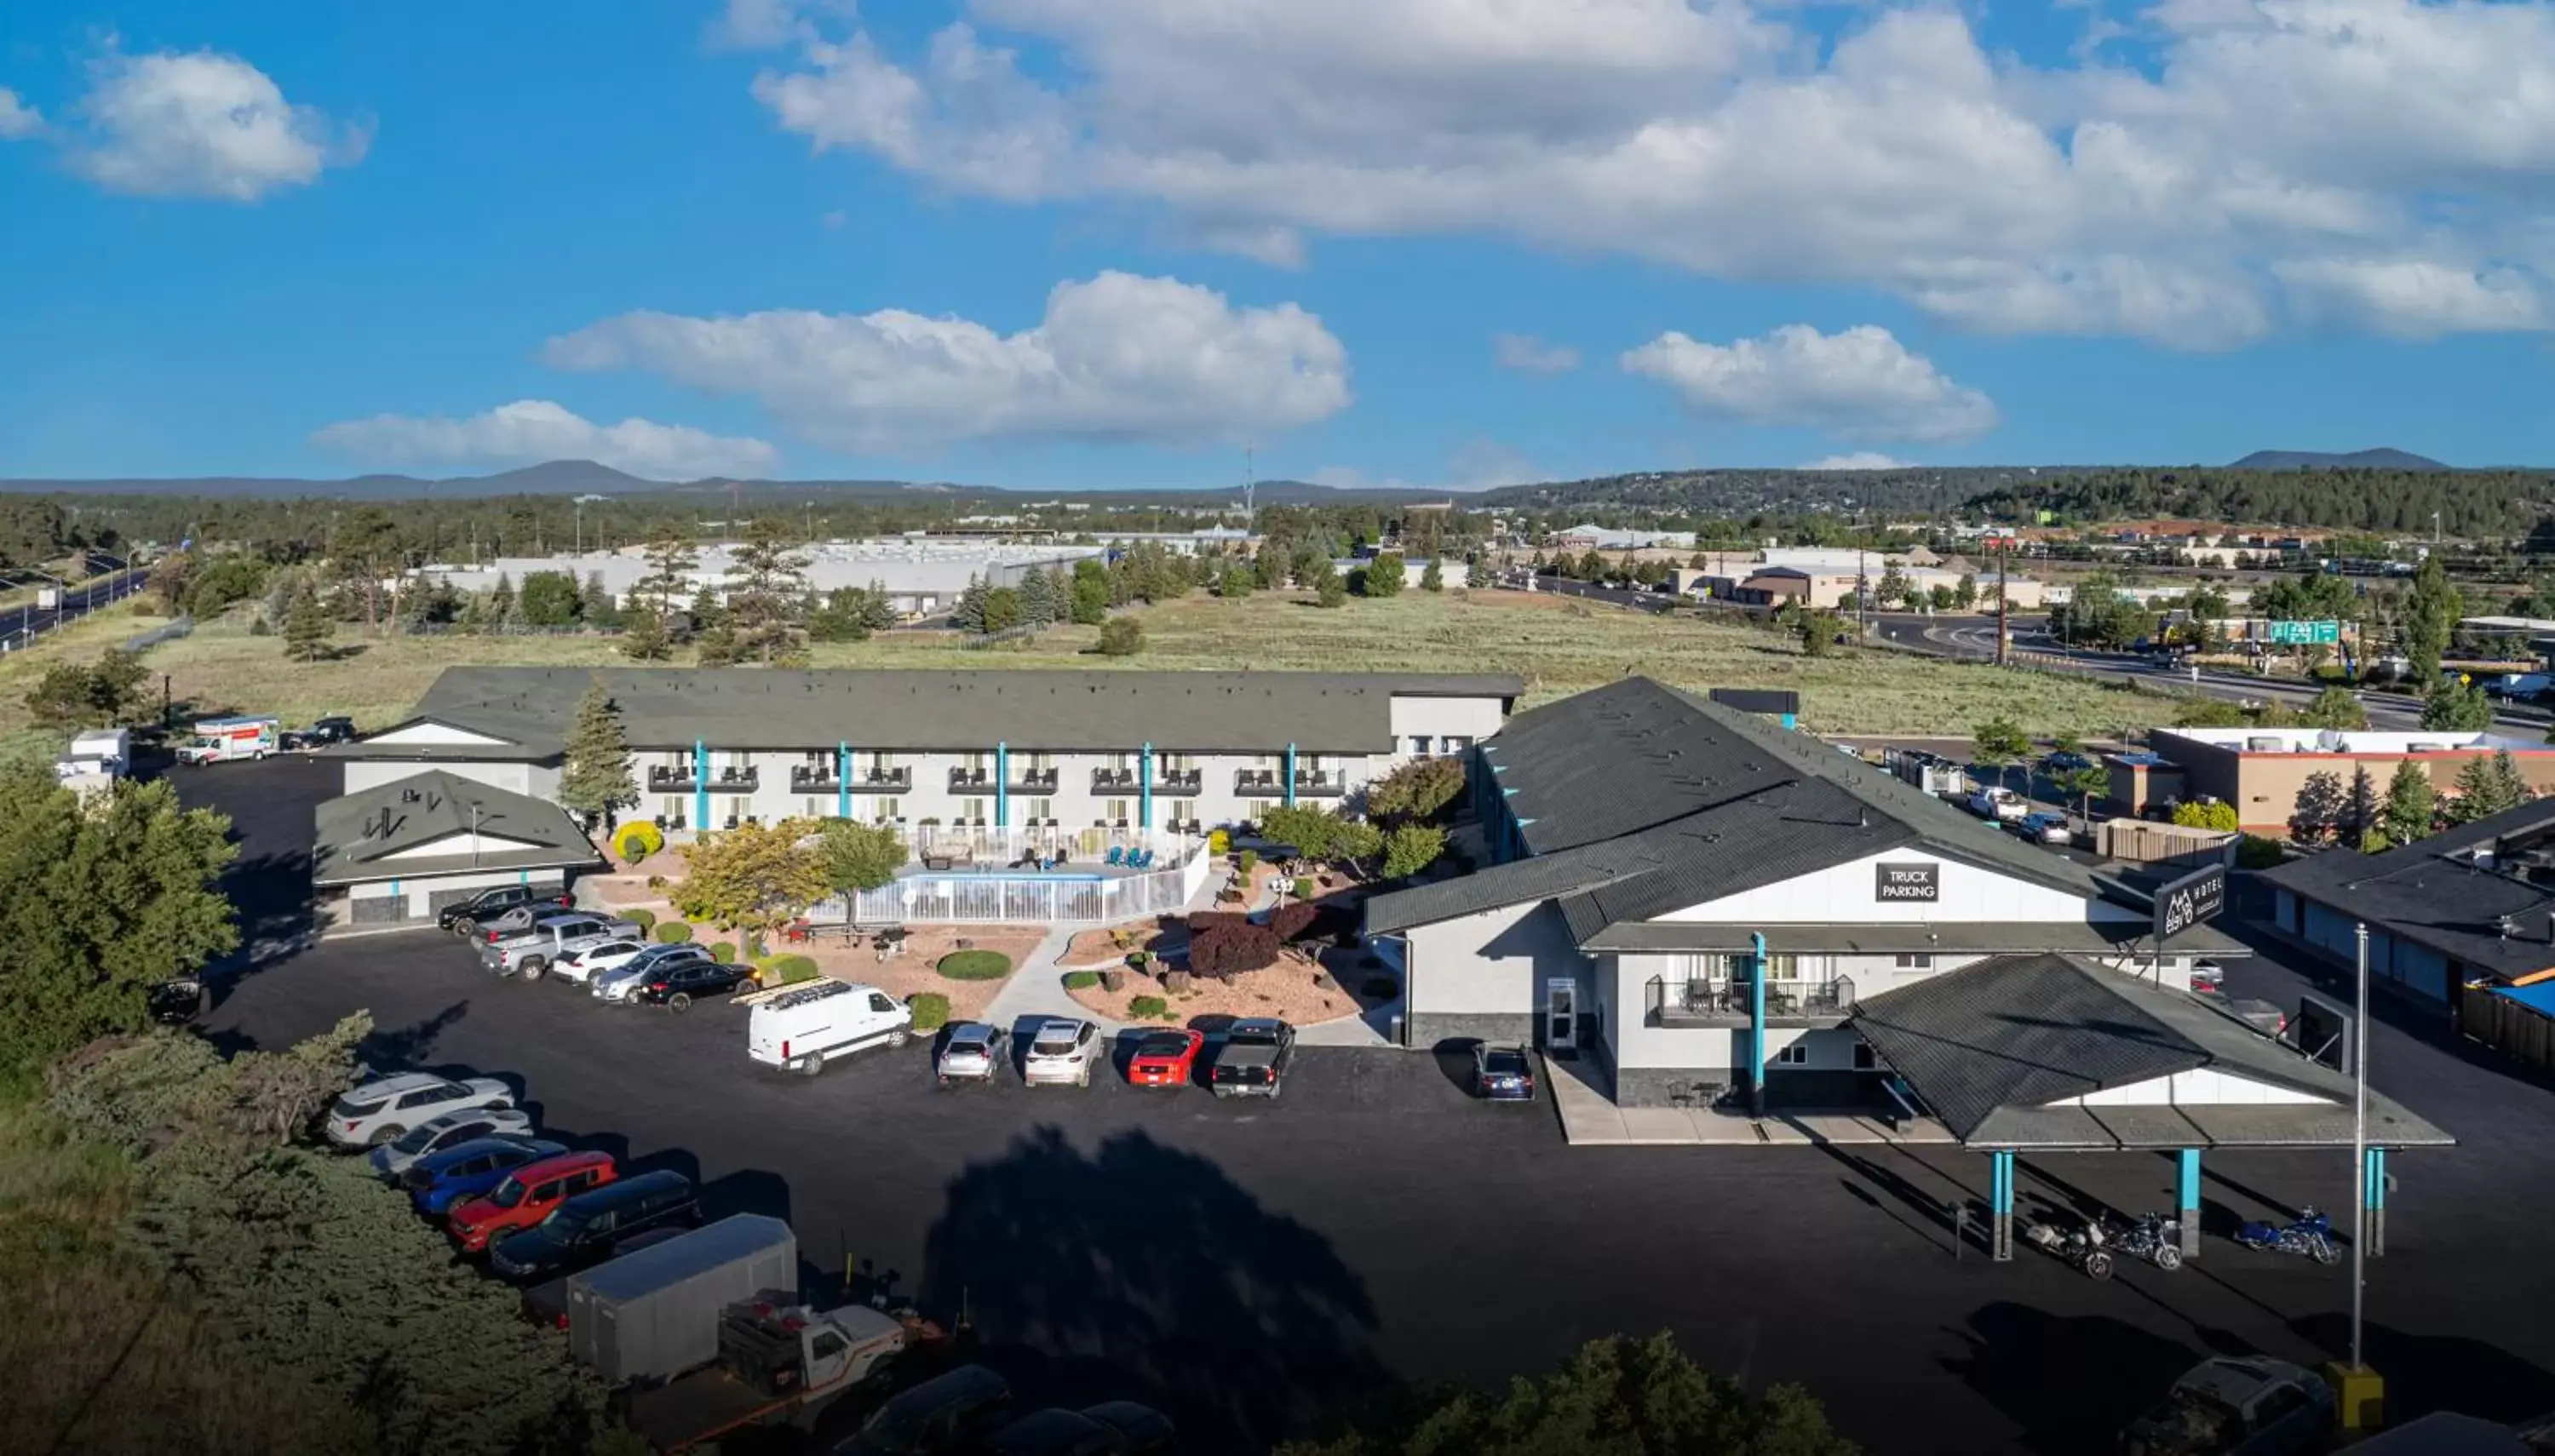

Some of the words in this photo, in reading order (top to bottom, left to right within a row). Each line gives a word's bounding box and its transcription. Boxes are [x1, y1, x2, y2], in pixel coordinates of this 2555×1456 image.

[1890, 872, 1928, 882] TRUCK
[1883, 886, 1935, 897] PARKING
[2194, 877, 2222, 900] HOTEL
